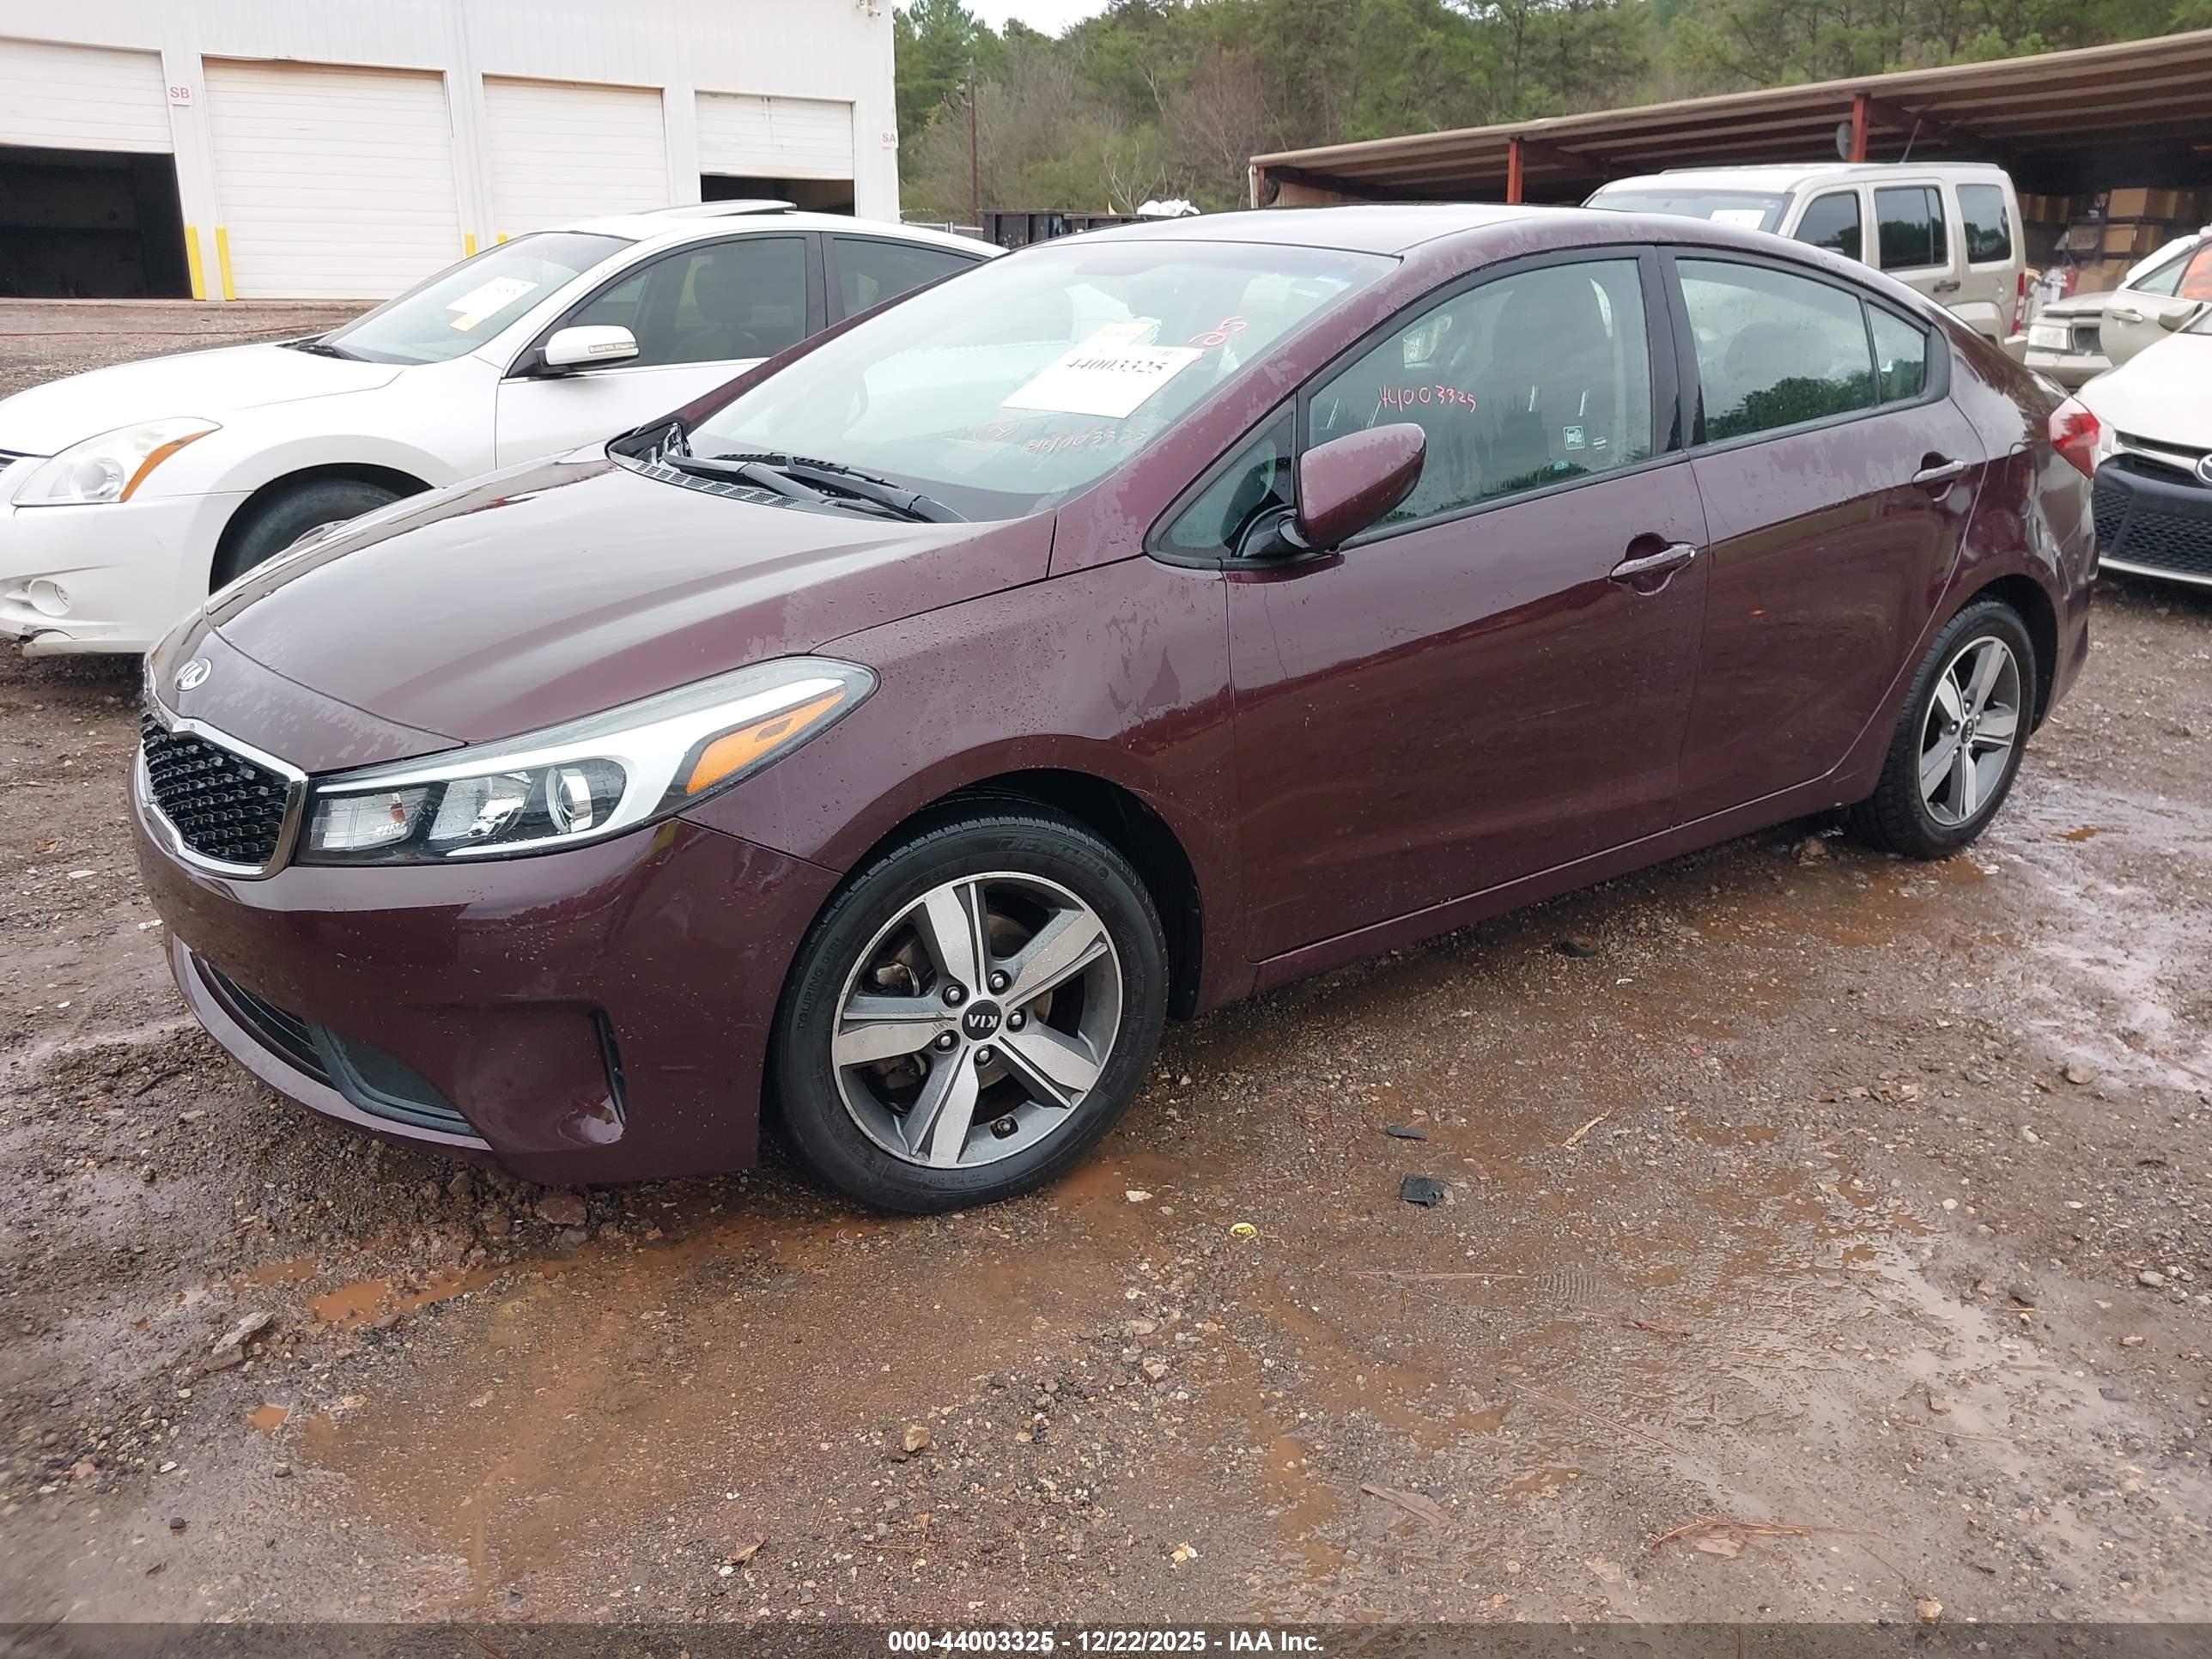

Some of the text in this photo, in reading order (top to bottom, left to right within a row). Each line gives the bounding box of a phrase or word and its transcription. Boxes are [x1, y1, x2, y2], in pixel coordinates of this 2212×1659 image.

[170, 86, 191, 99] SB
[882, 131, 896, 144] SA
[1064, 357, 1169, 374] 44003325
[1377, 384, 1477, 413] 44003325
[796, 966, 826, 1032] TOURING
[967, 1012, 1000, 1030] KIA
